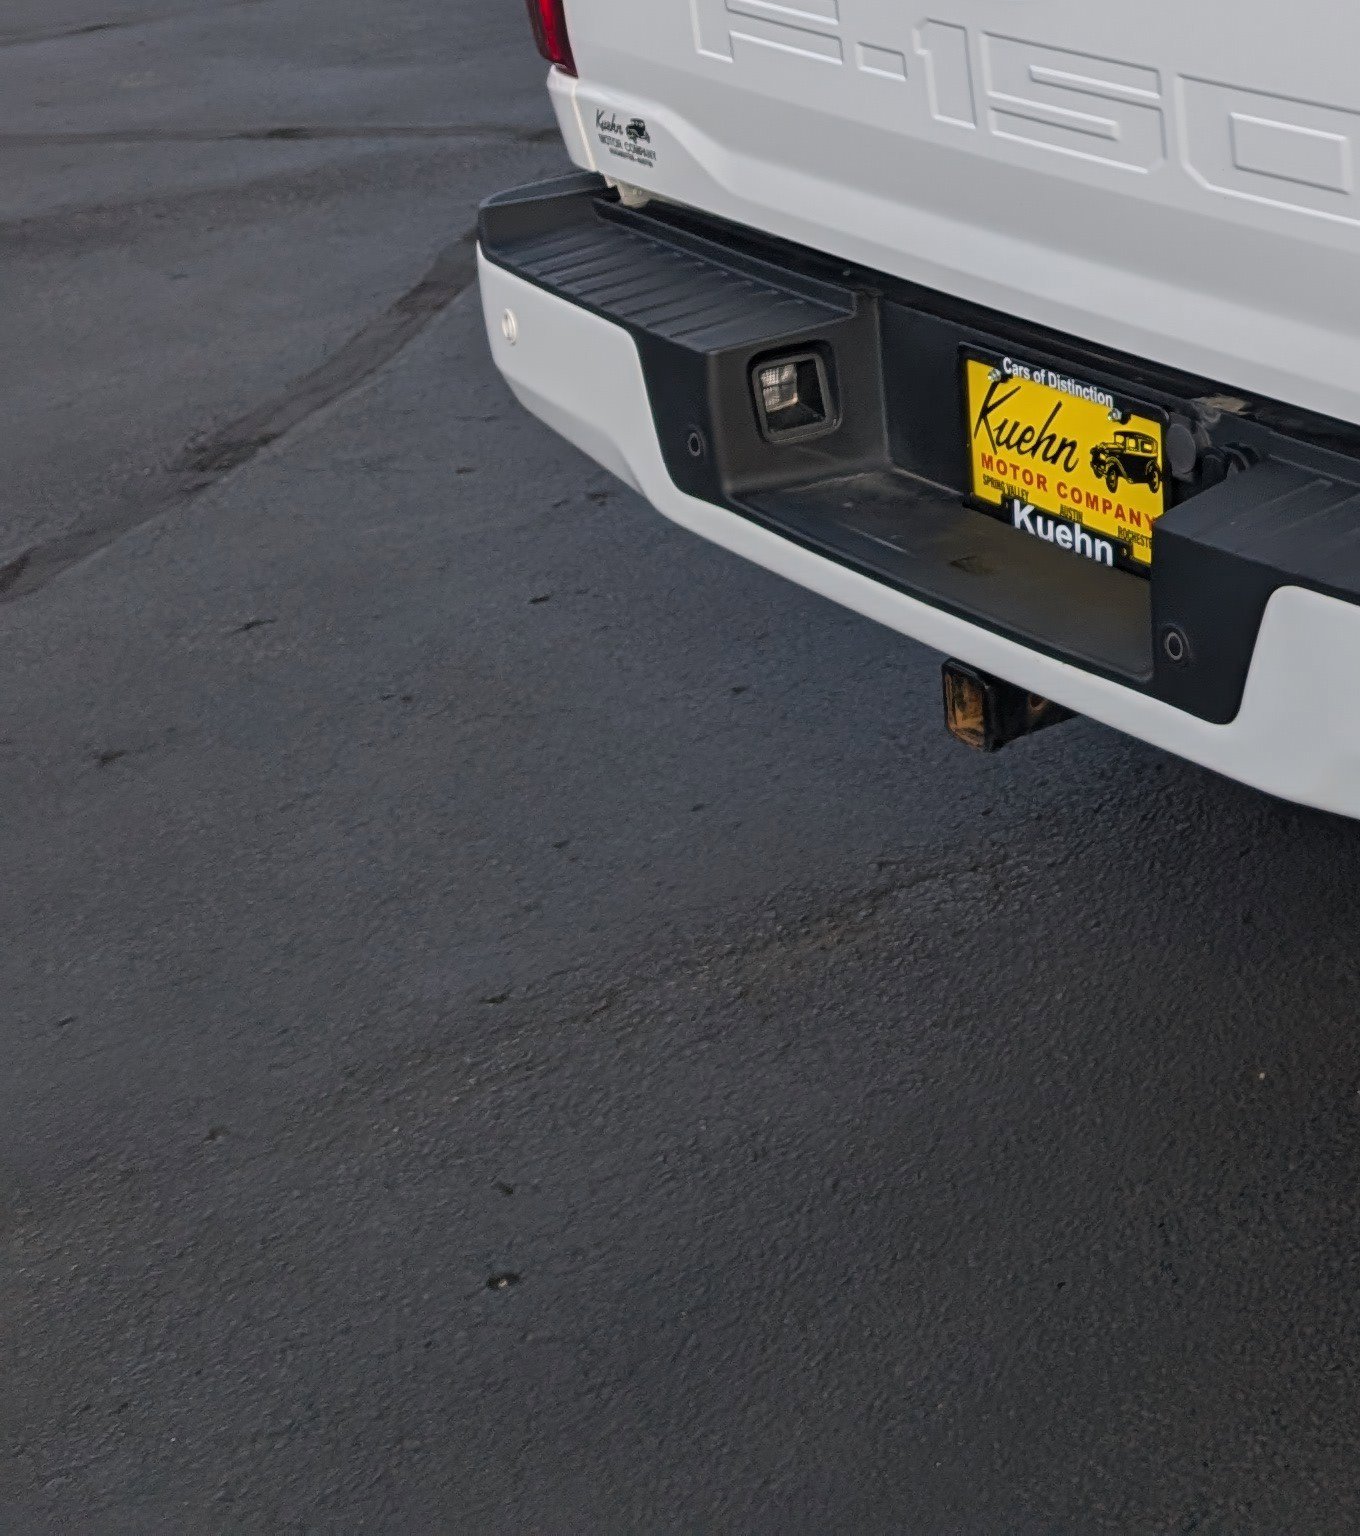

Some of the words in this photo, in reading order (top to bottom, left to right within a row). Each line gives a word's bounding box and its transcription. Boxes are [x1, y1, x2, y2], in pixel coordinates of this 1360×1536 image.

[1002, 356, 1030, 380] Cars
[1033, 368, 1046, 384] of
[1048, 371, 1114, 409] Distinction
[973, 381, 1080, 473] Kuehn
[980, 452, 1048, 493] MOTOR
[1056, 481, 1154, 532] COMPANY
[1013, 498, 1113, 567] Kuehn
